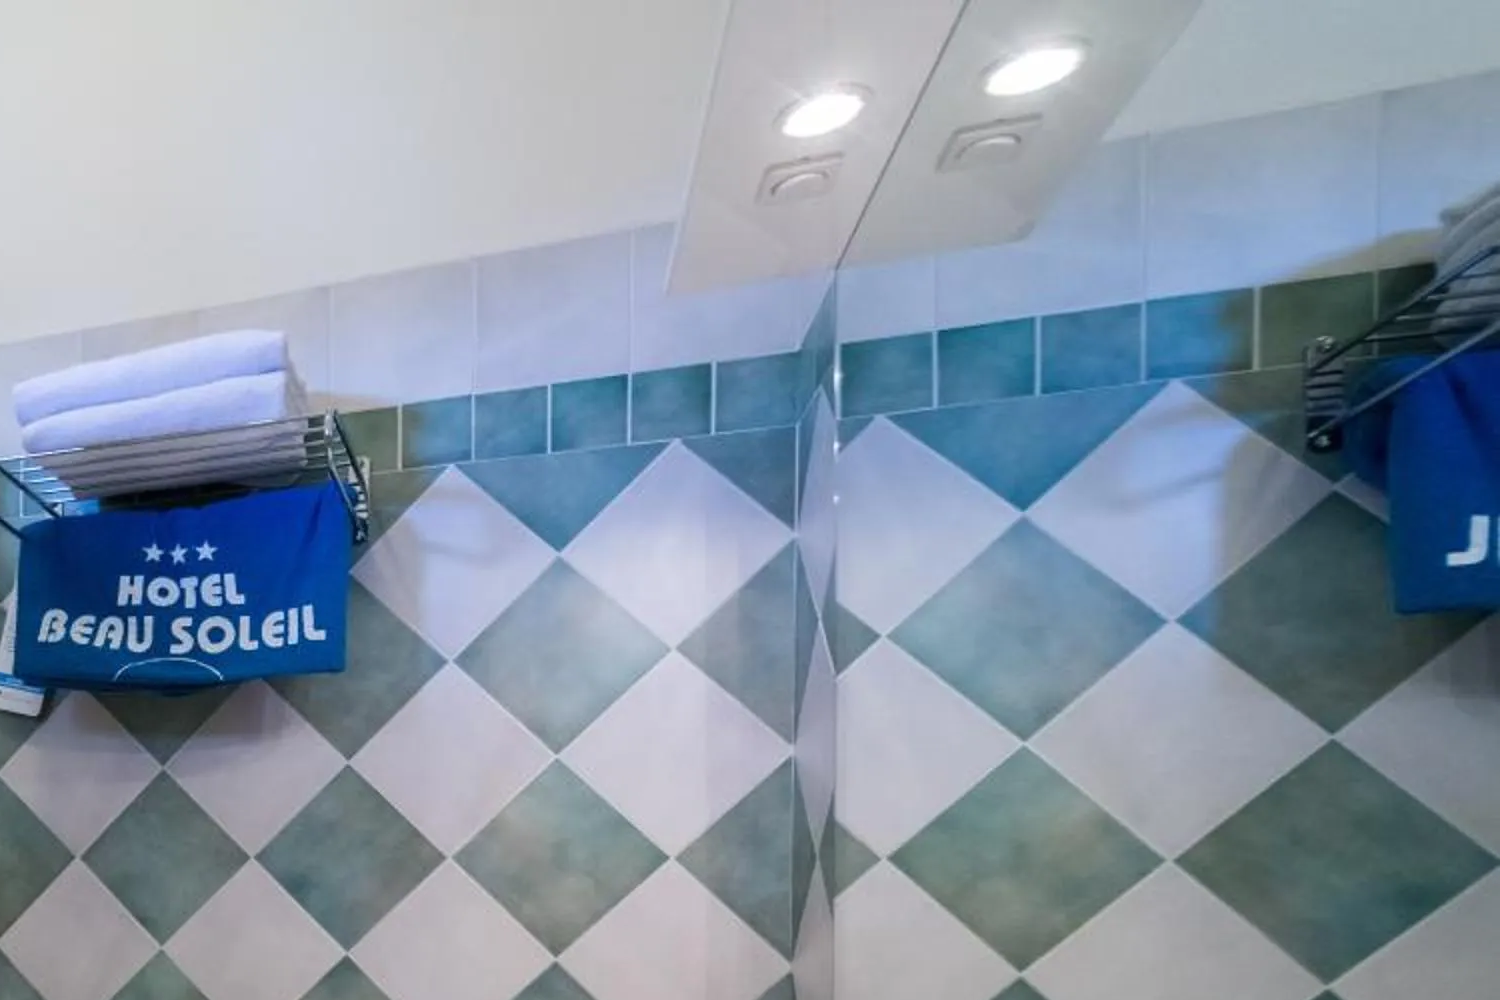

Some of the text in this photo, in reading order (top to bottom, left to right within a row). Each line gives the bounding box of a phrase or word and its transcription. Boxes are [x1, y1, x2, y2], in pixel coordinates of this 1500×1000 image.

[117, 573, 245, 608] HOTEL
[37, 609, 154, 653] BEAU
[169, 605, 326, 654] SOLEIL
